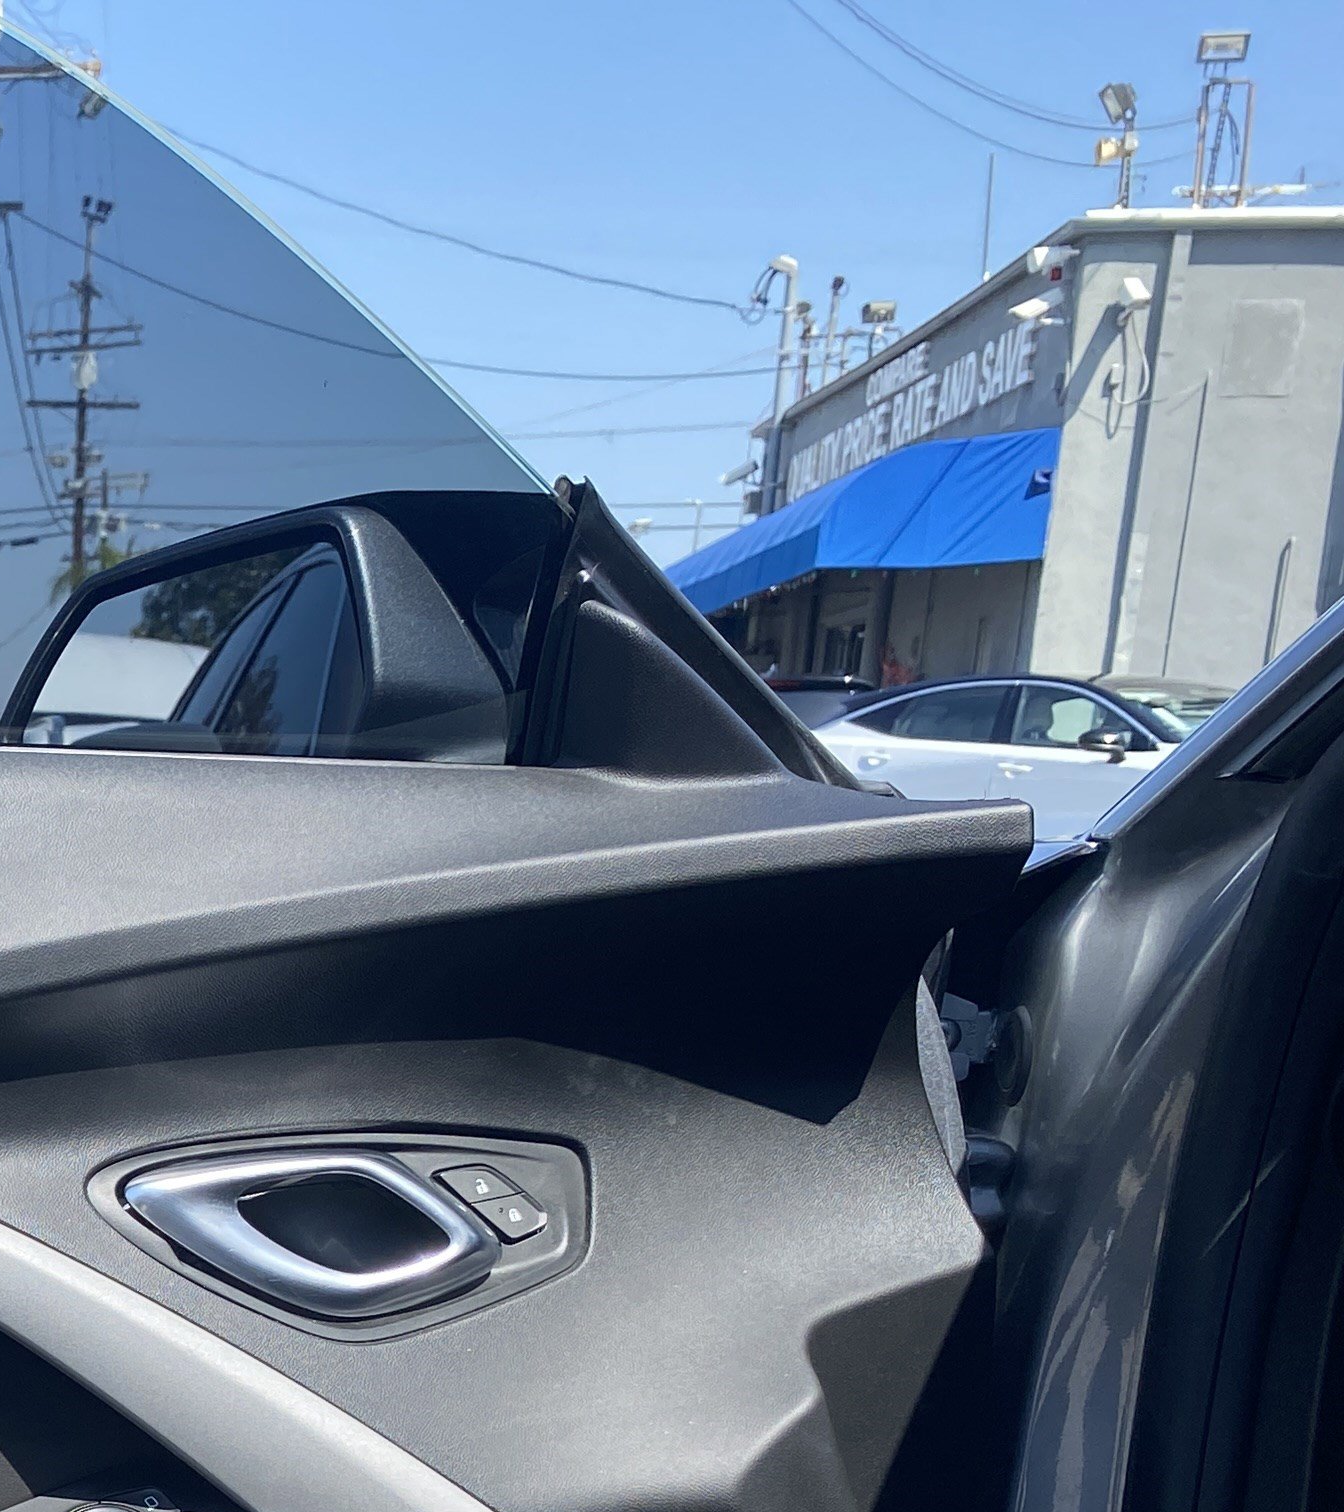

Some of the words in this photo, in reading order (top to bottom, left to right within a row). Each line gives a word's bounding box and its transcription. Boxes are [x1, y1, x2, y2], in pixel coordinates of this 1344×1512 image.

[889, 373, 938, 451] RATE
[933, 350, 977, 428] AND
[978, 318, 1037, 406] SAVE
